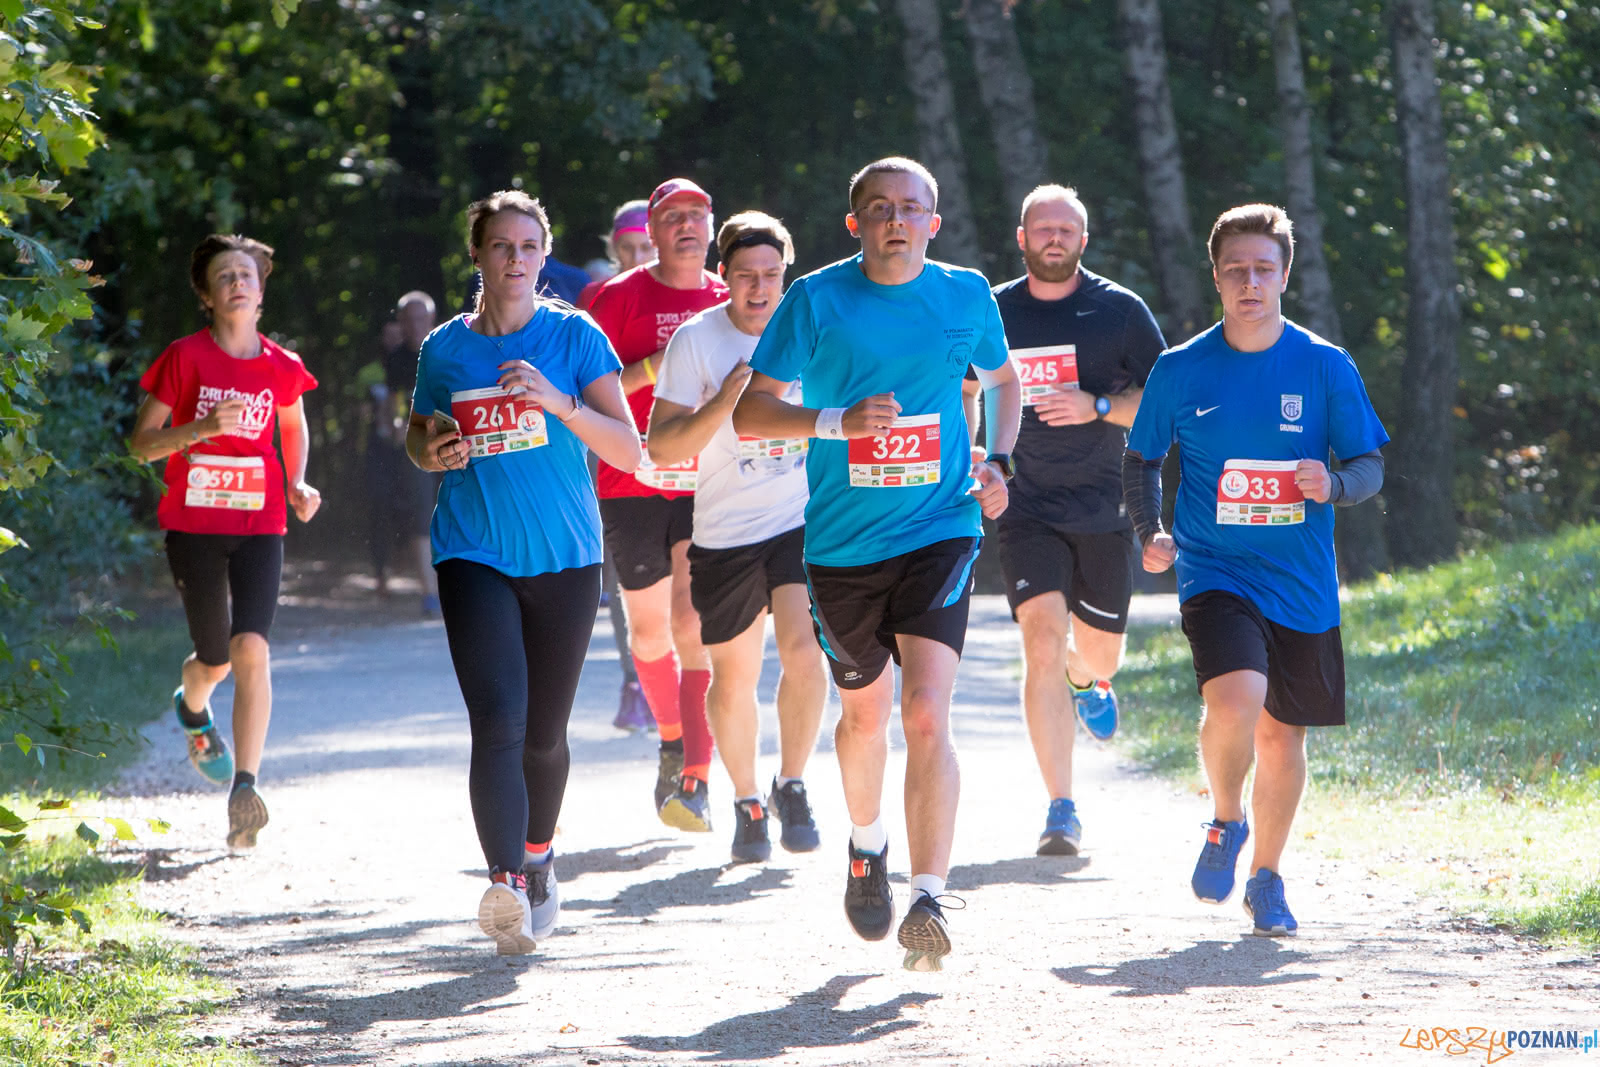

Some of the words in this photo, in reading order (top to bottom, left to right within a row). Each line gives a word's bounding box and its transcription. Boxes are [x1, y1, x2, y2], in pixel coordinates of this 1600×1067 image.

[1020, 361, 1058, 382] 245
[473, 402, 517, 430] 261
[872, 434, 921, 460] 322
[208, 470, 245, 489] 591
[1249, 477, 1280, 500] 33
